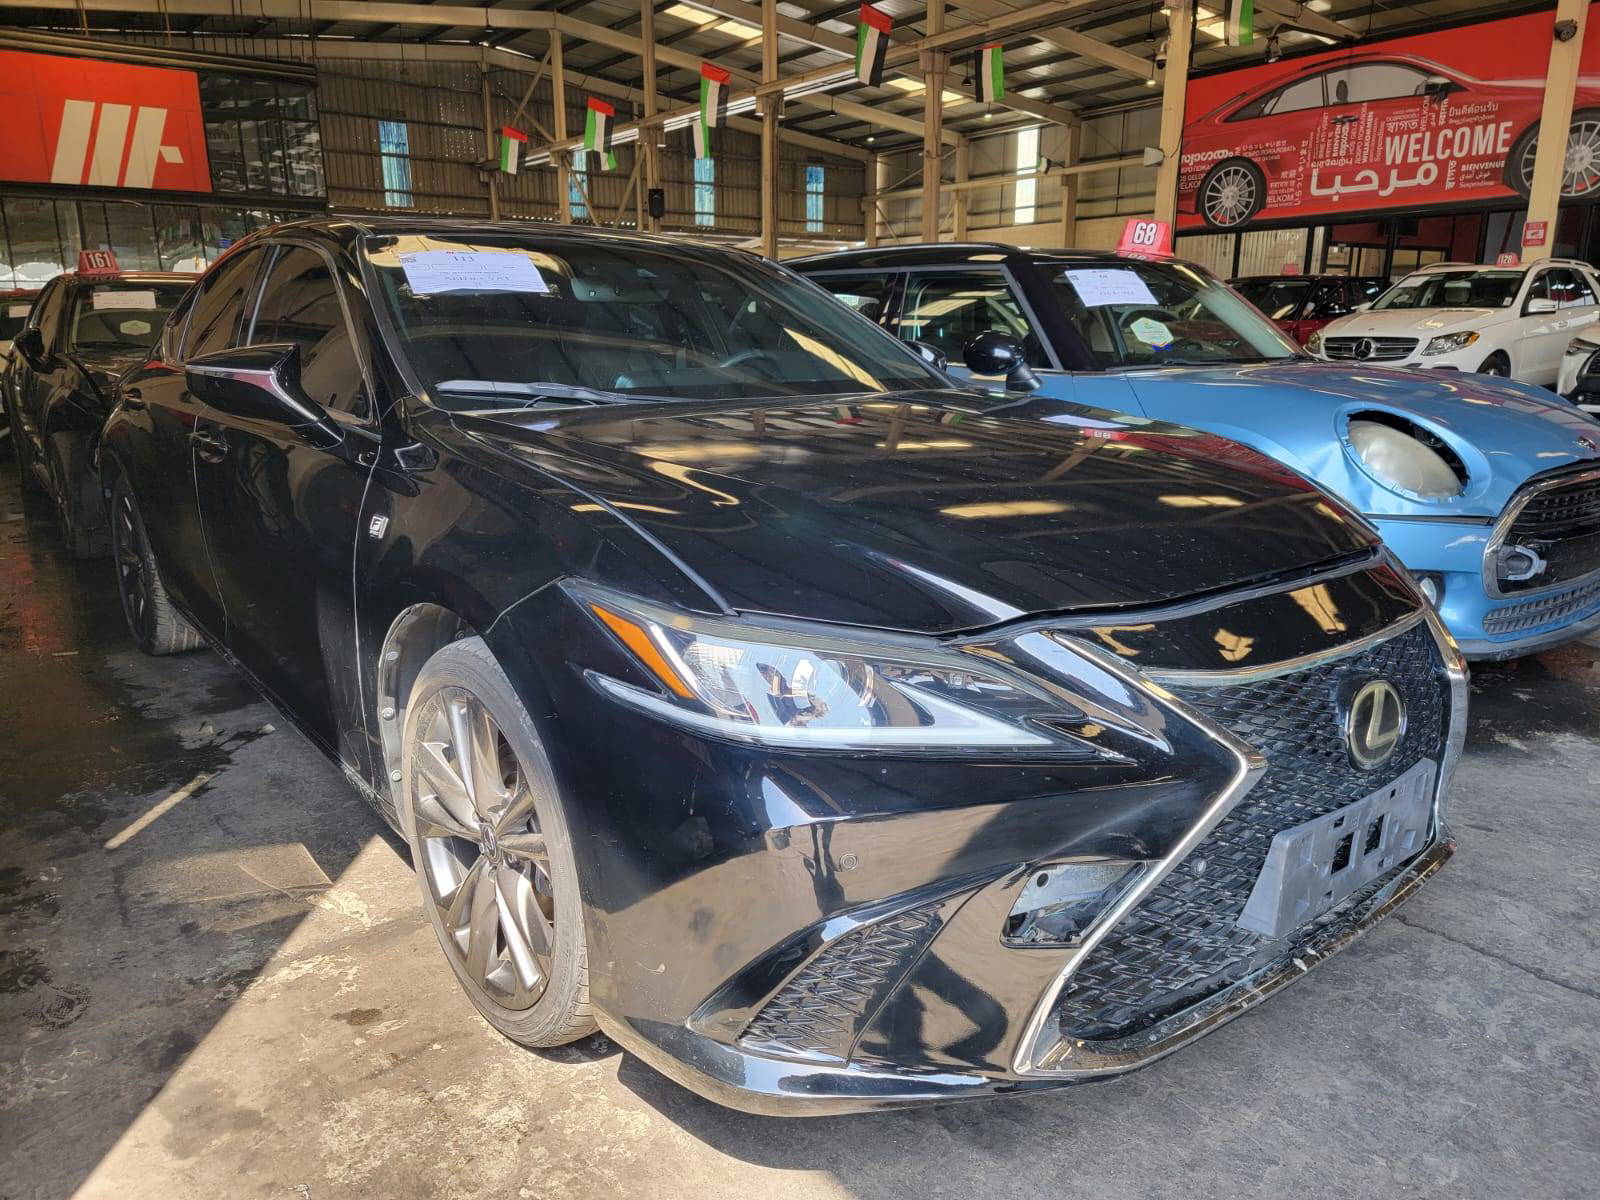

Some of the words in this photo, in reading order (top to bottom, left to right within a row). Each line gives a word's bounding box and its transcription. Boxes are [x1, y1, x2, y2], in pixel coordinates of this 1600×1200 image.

[1385, 121, 1513, 165] WELCOME
[1310, 161, 1438, 201] مرحبا
[1132, 222, 1157, 246] 68
[88, 252, 112, 268] 161
